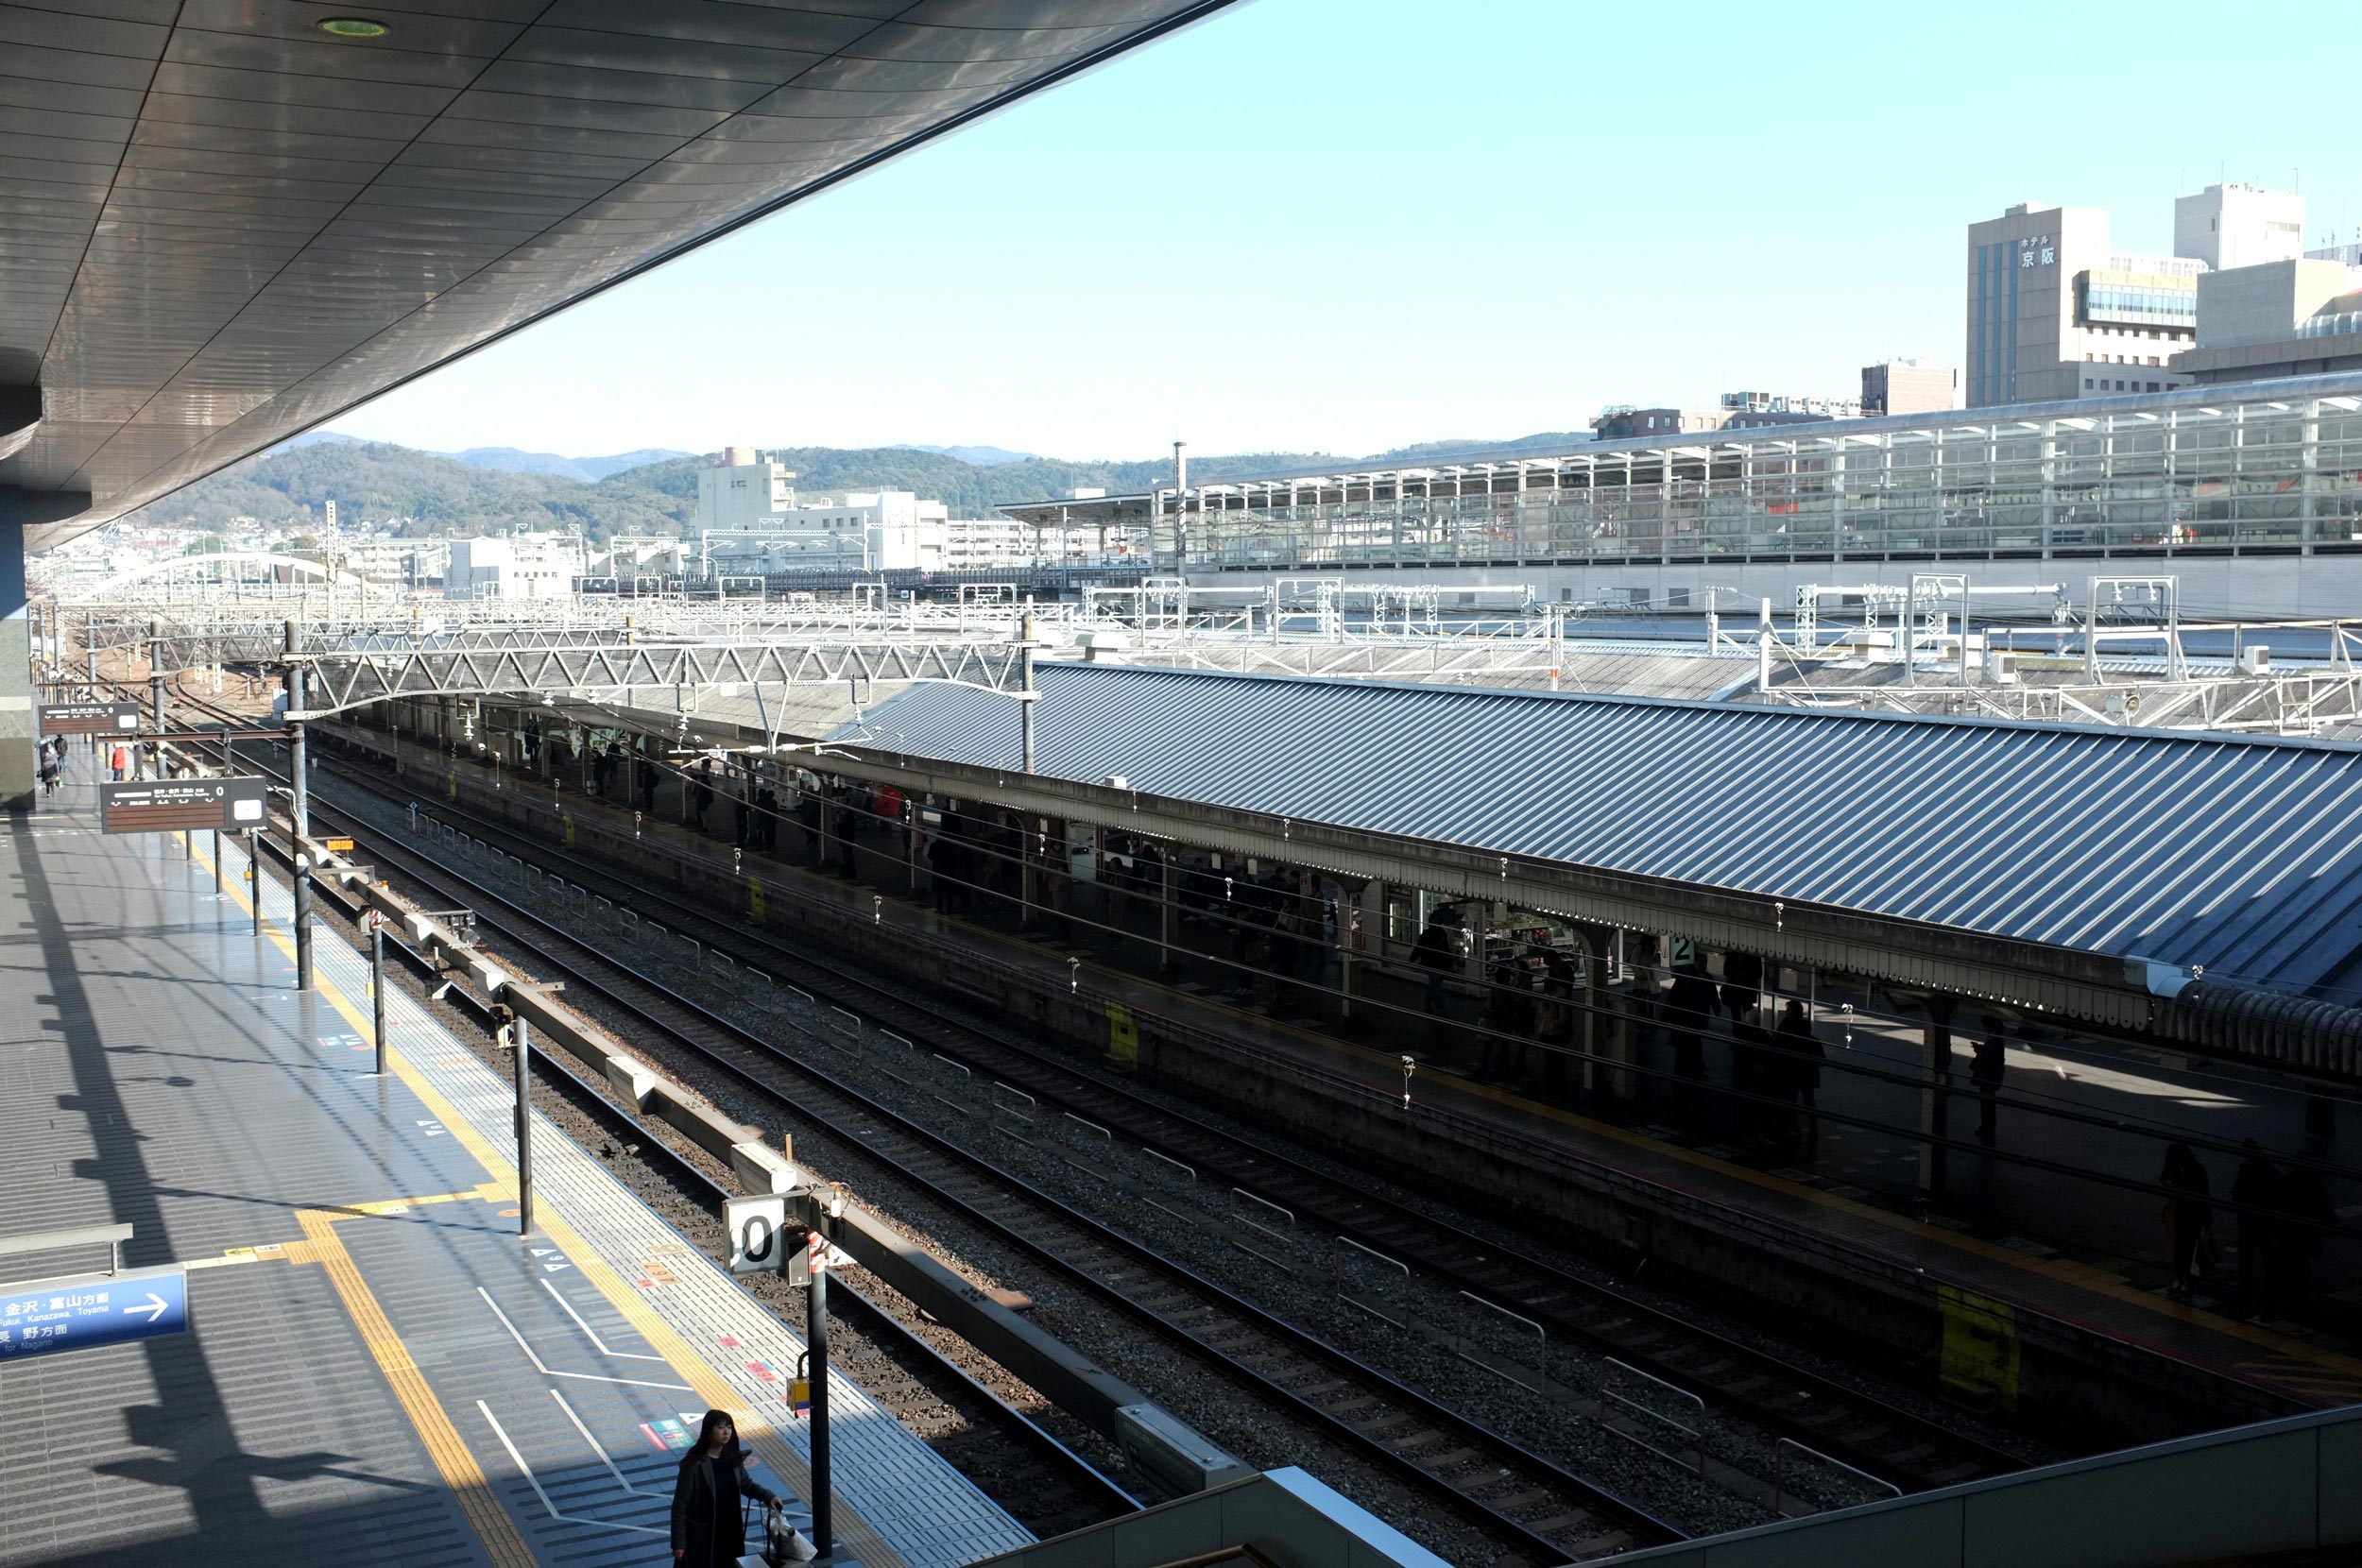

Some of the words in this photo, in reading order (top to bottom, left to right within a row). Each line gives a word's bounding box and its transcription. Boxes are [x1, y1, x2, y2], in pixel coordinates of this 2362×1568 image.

[2021, 235, 2048, 247] ホテル
[2022, 247, 2054, 267] 京阪
[618, 727, 625, 738] 2
[215, 786, 224, 796] 0
[1675, 936, 1690, 961] 2
[742, 1215, 773, 1262] 0
[77, 1304, 110, 1316] Toyama
[21, 1339, 53, 1350] Nagano
